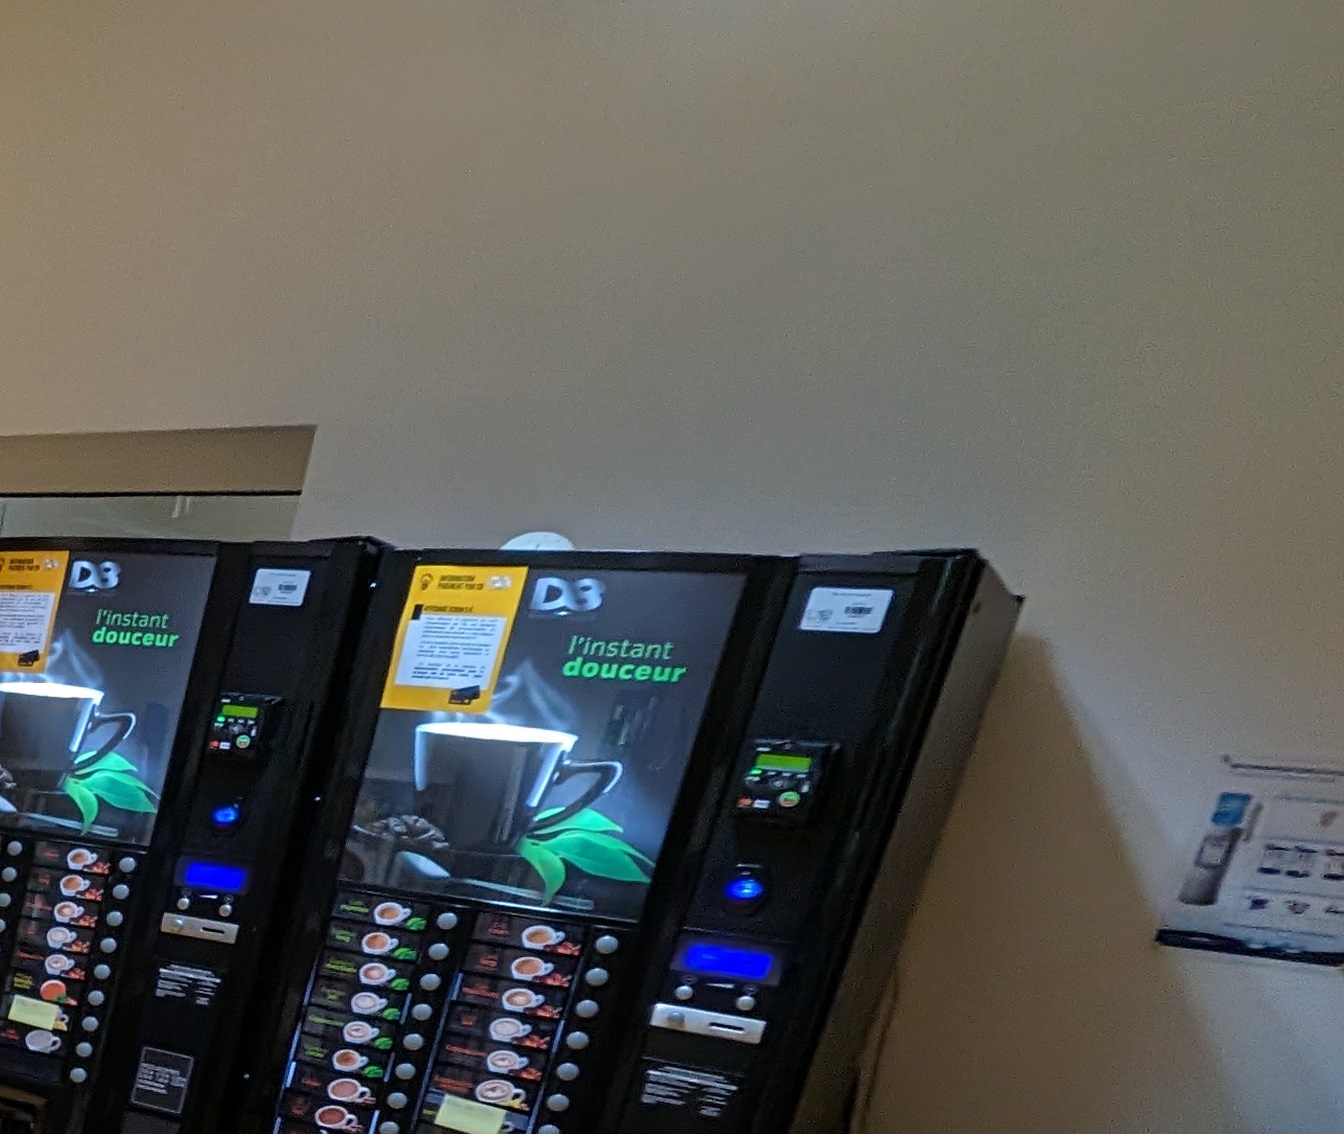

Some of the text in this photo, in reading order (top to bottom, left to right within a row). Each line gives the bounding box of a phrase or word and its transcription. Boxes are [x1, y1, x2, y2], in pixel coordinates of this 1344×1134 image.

[96, 609, 169, 629] l'instant
[92, 627, 179, 648] douceur
[568, 635, 673, 660] l'instant
[562, 656, 687, 684] douceur
